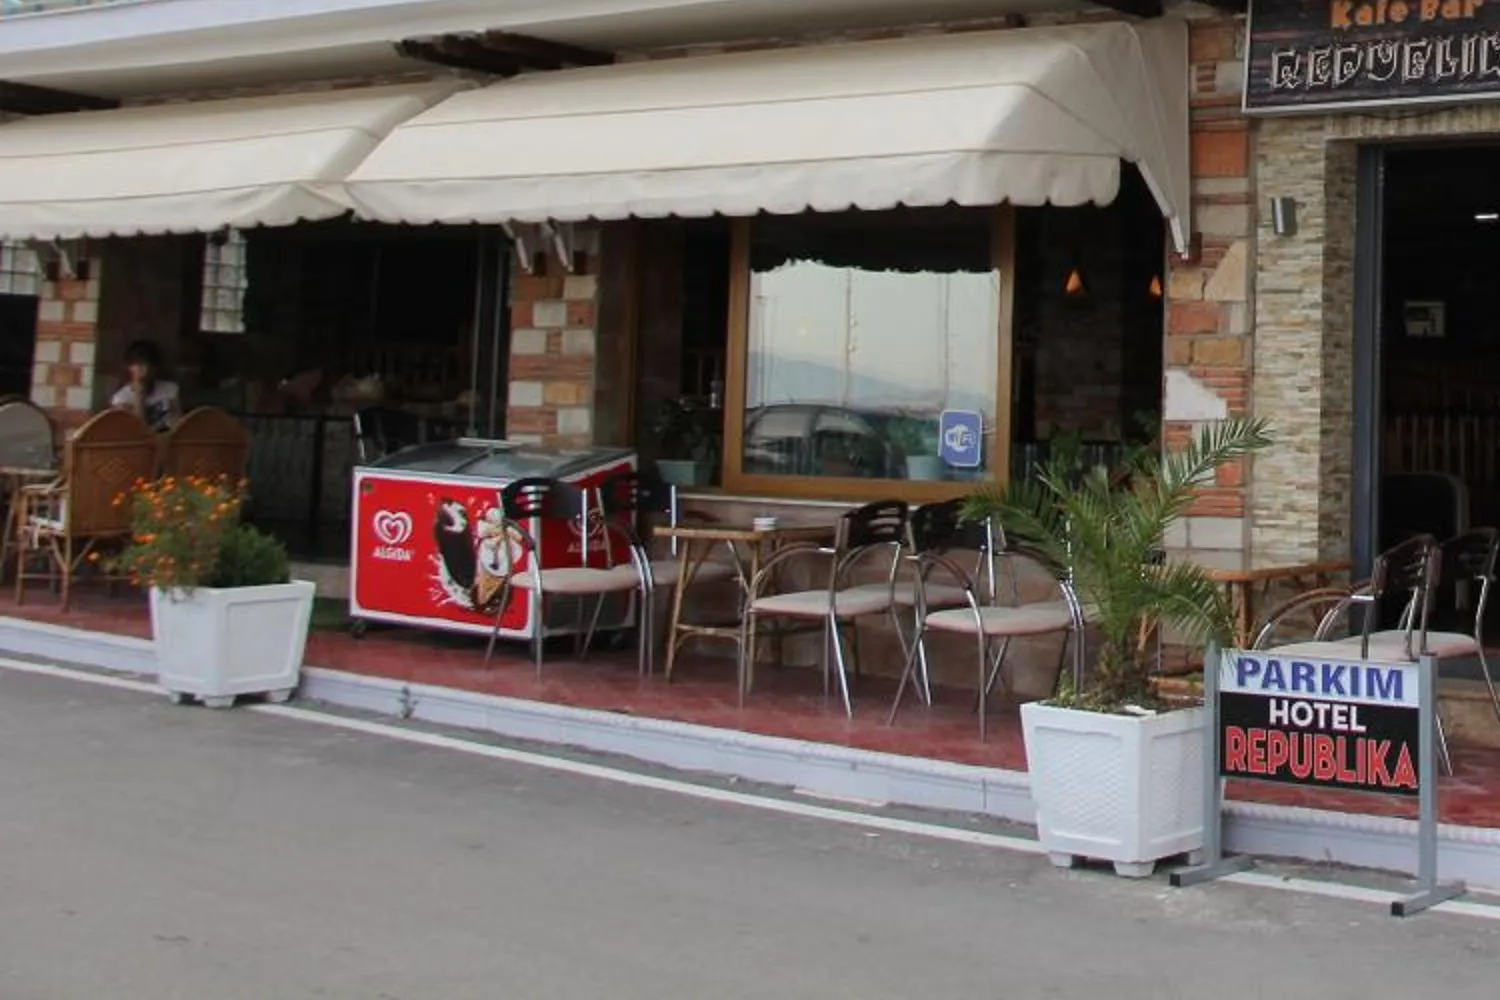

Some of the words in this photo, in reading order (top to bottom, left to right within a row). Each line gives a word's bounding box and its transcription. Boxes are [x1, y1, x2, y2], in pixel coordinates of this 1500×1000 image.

[1237, 657, 1404, 700] PARKIM
[1269, 698, 1367, 732] HOTEL
[1225, 725, 1418, 789] REPUBLIKA
